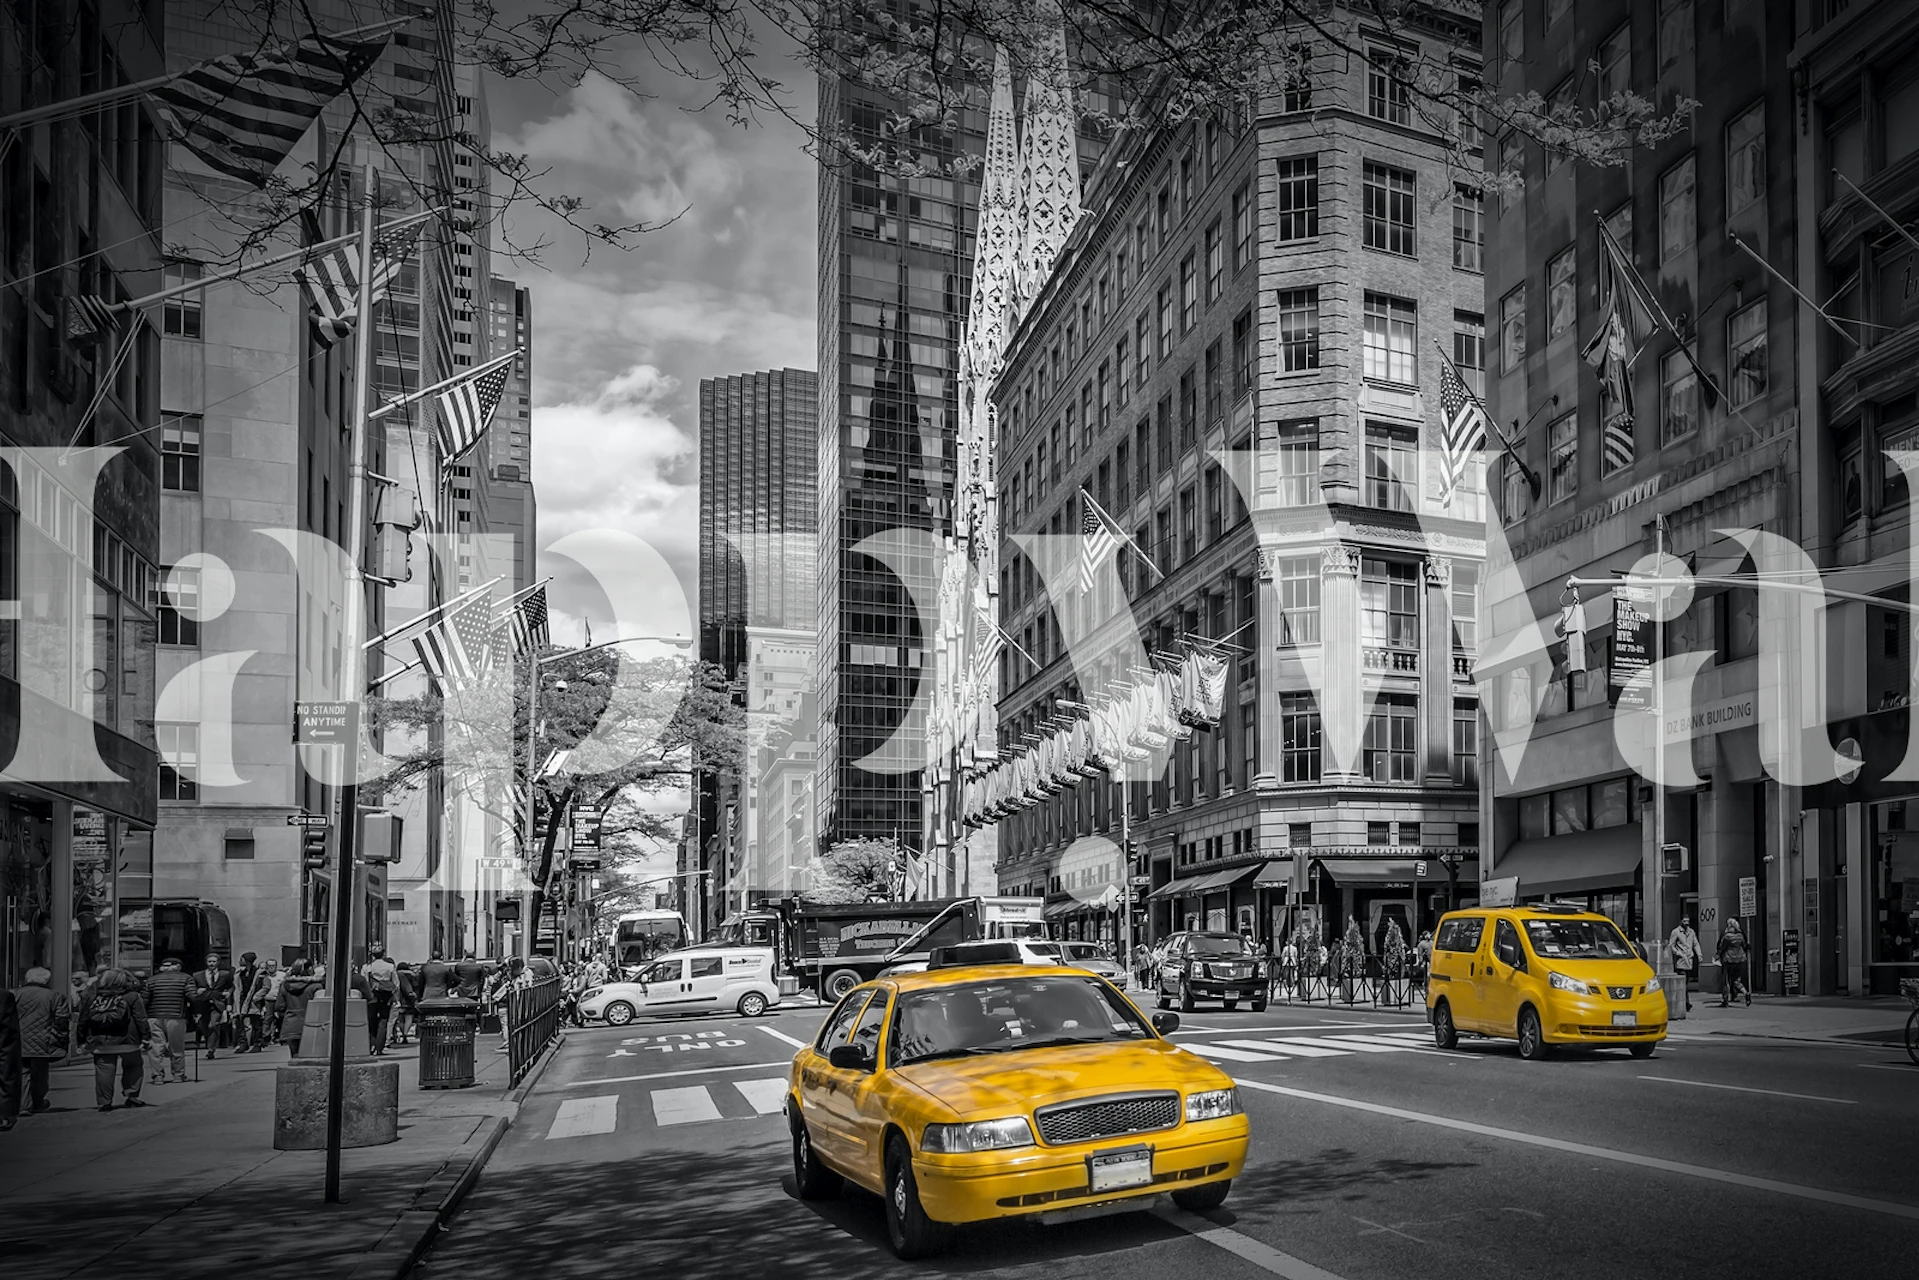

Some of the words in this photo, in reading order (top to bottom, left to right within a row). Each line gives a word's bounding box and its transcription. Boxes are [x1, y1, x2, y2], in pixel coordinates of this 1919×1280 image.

[1616, 600, 1633, 612] THE
[1616, 610, 1651, 623] MAKEUP
[1616, 619, 1641, 632] SHOW
[297, 706, 310, 715] NO
[303, 717, 347, 727] ANYTIME
[1666, 720, 1679, 735] DZ
[1680, 713, 1705, 732] BANK
[1706, 702, 1752, 726] BUILDING
[493, 859, 505, 867] 49
[1700, 907, 1716, 922] 609
